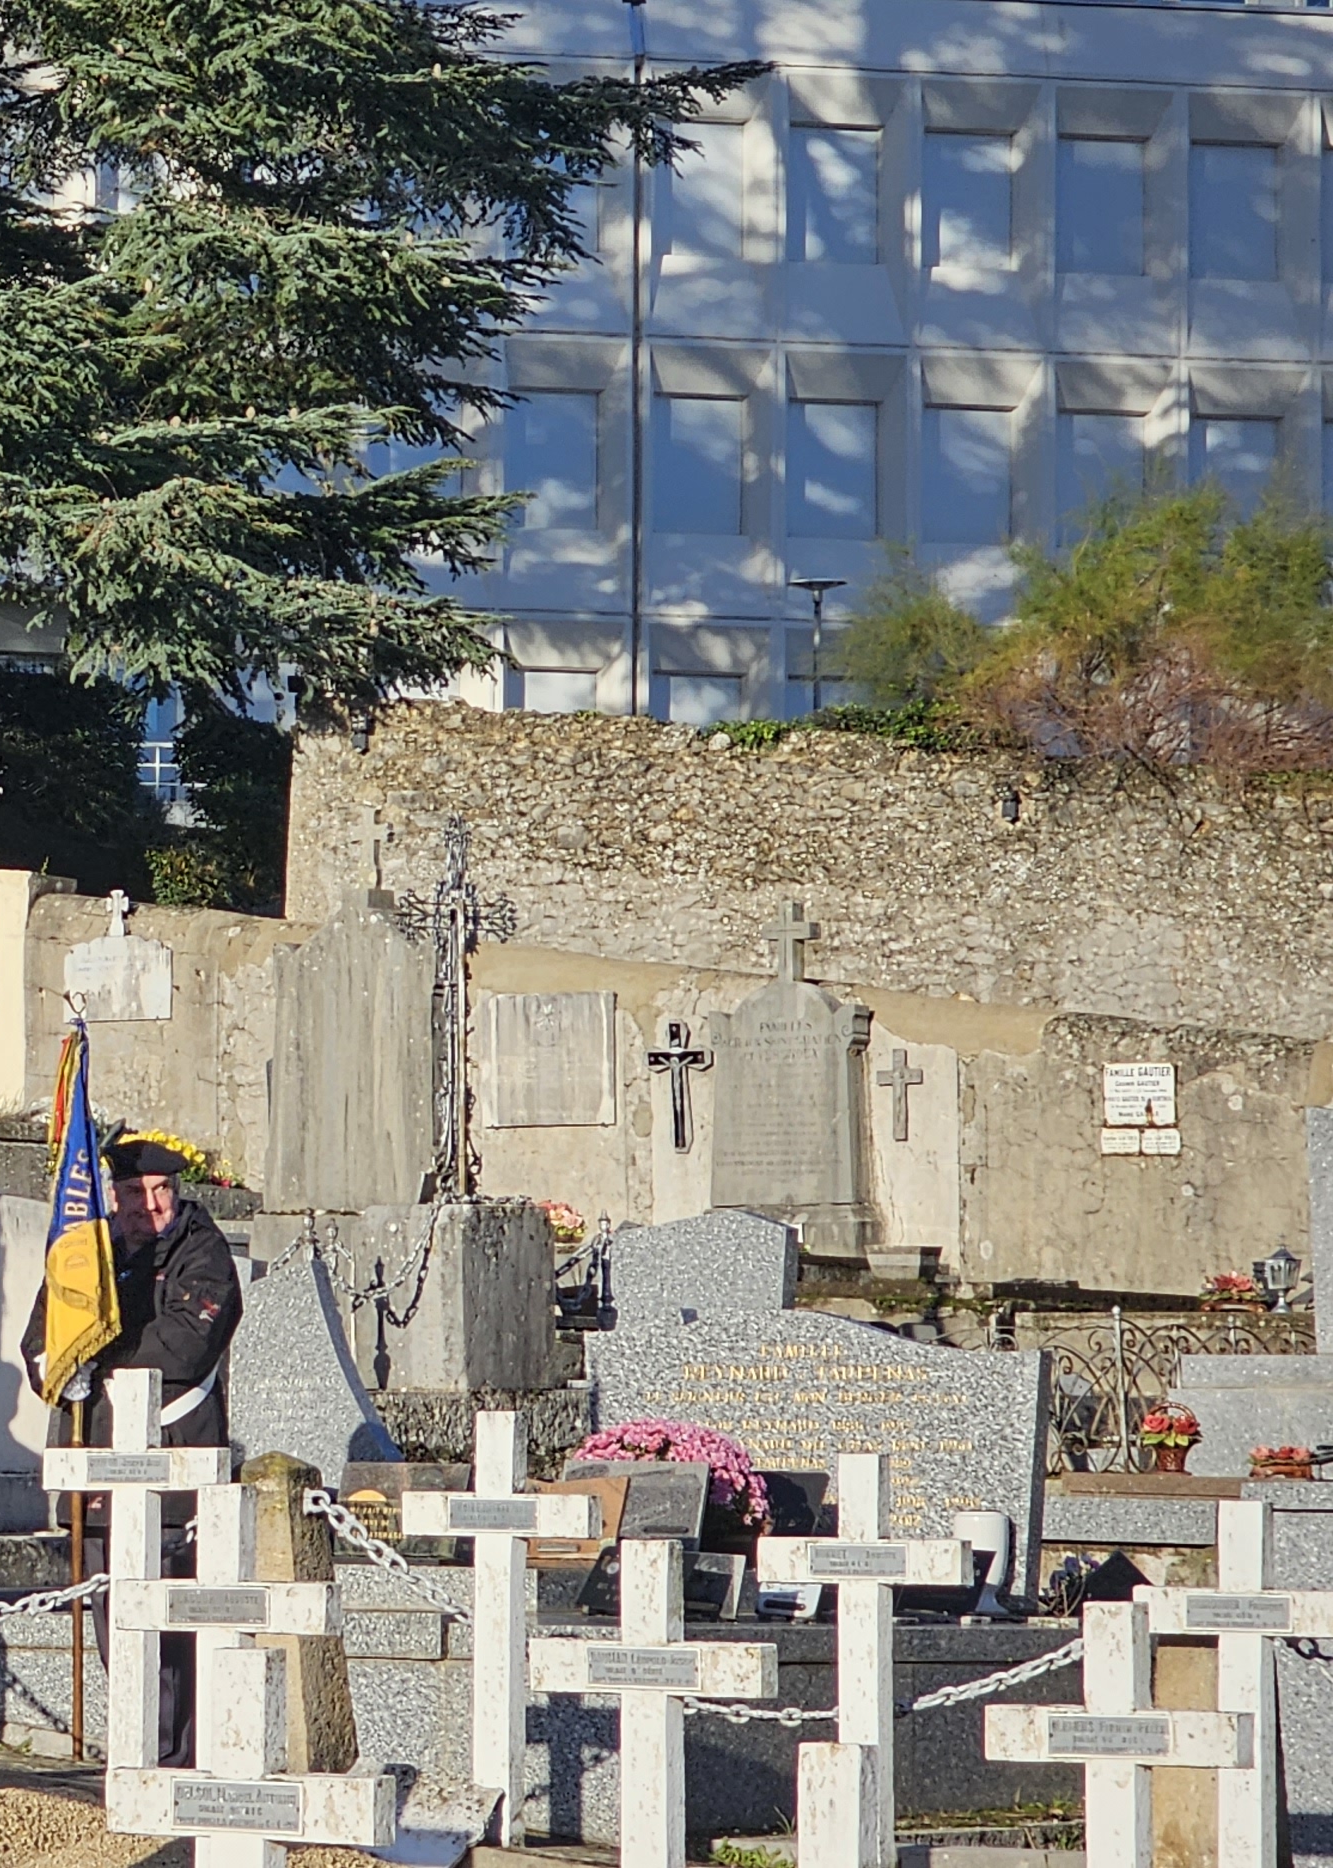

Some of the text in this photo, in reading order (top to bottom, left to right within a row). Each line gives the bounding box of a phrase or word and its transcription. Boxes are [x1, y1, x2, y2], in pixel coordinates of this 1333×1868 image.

[1105, 1067, 1171, 1077] FAMILLE GAUTIER
[684, 1366, 788, 1381] REYNARD
[818, 1365, 927, 1381] TAUPENAS
